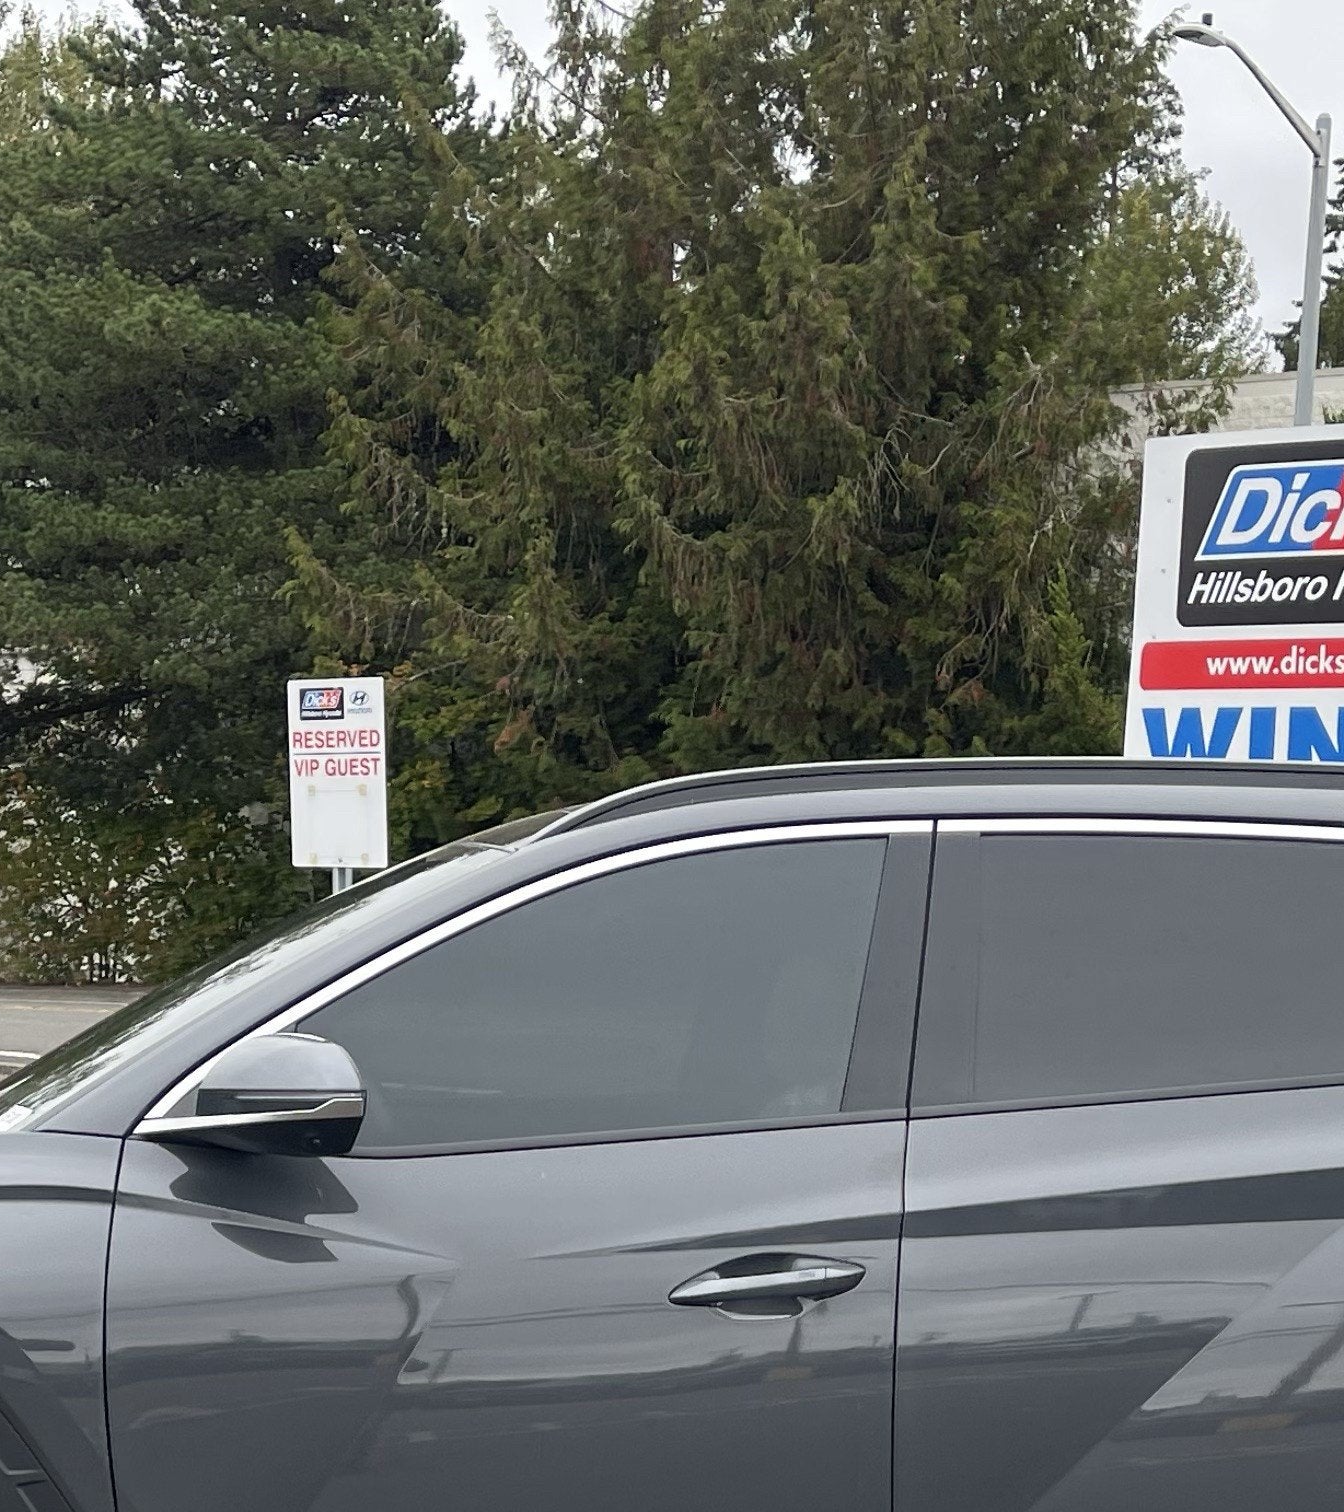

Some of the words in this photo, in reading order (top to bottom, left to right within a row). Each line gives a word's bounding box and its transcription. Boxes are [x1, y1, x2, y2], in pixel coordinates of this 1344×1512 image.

[1187, 568, 1329, 605] Hillsboro
[292, 729, 381, 749] RESERVED
[294, 759, 320, 777] VIP
[324, 758, 381, 777] GUEST
